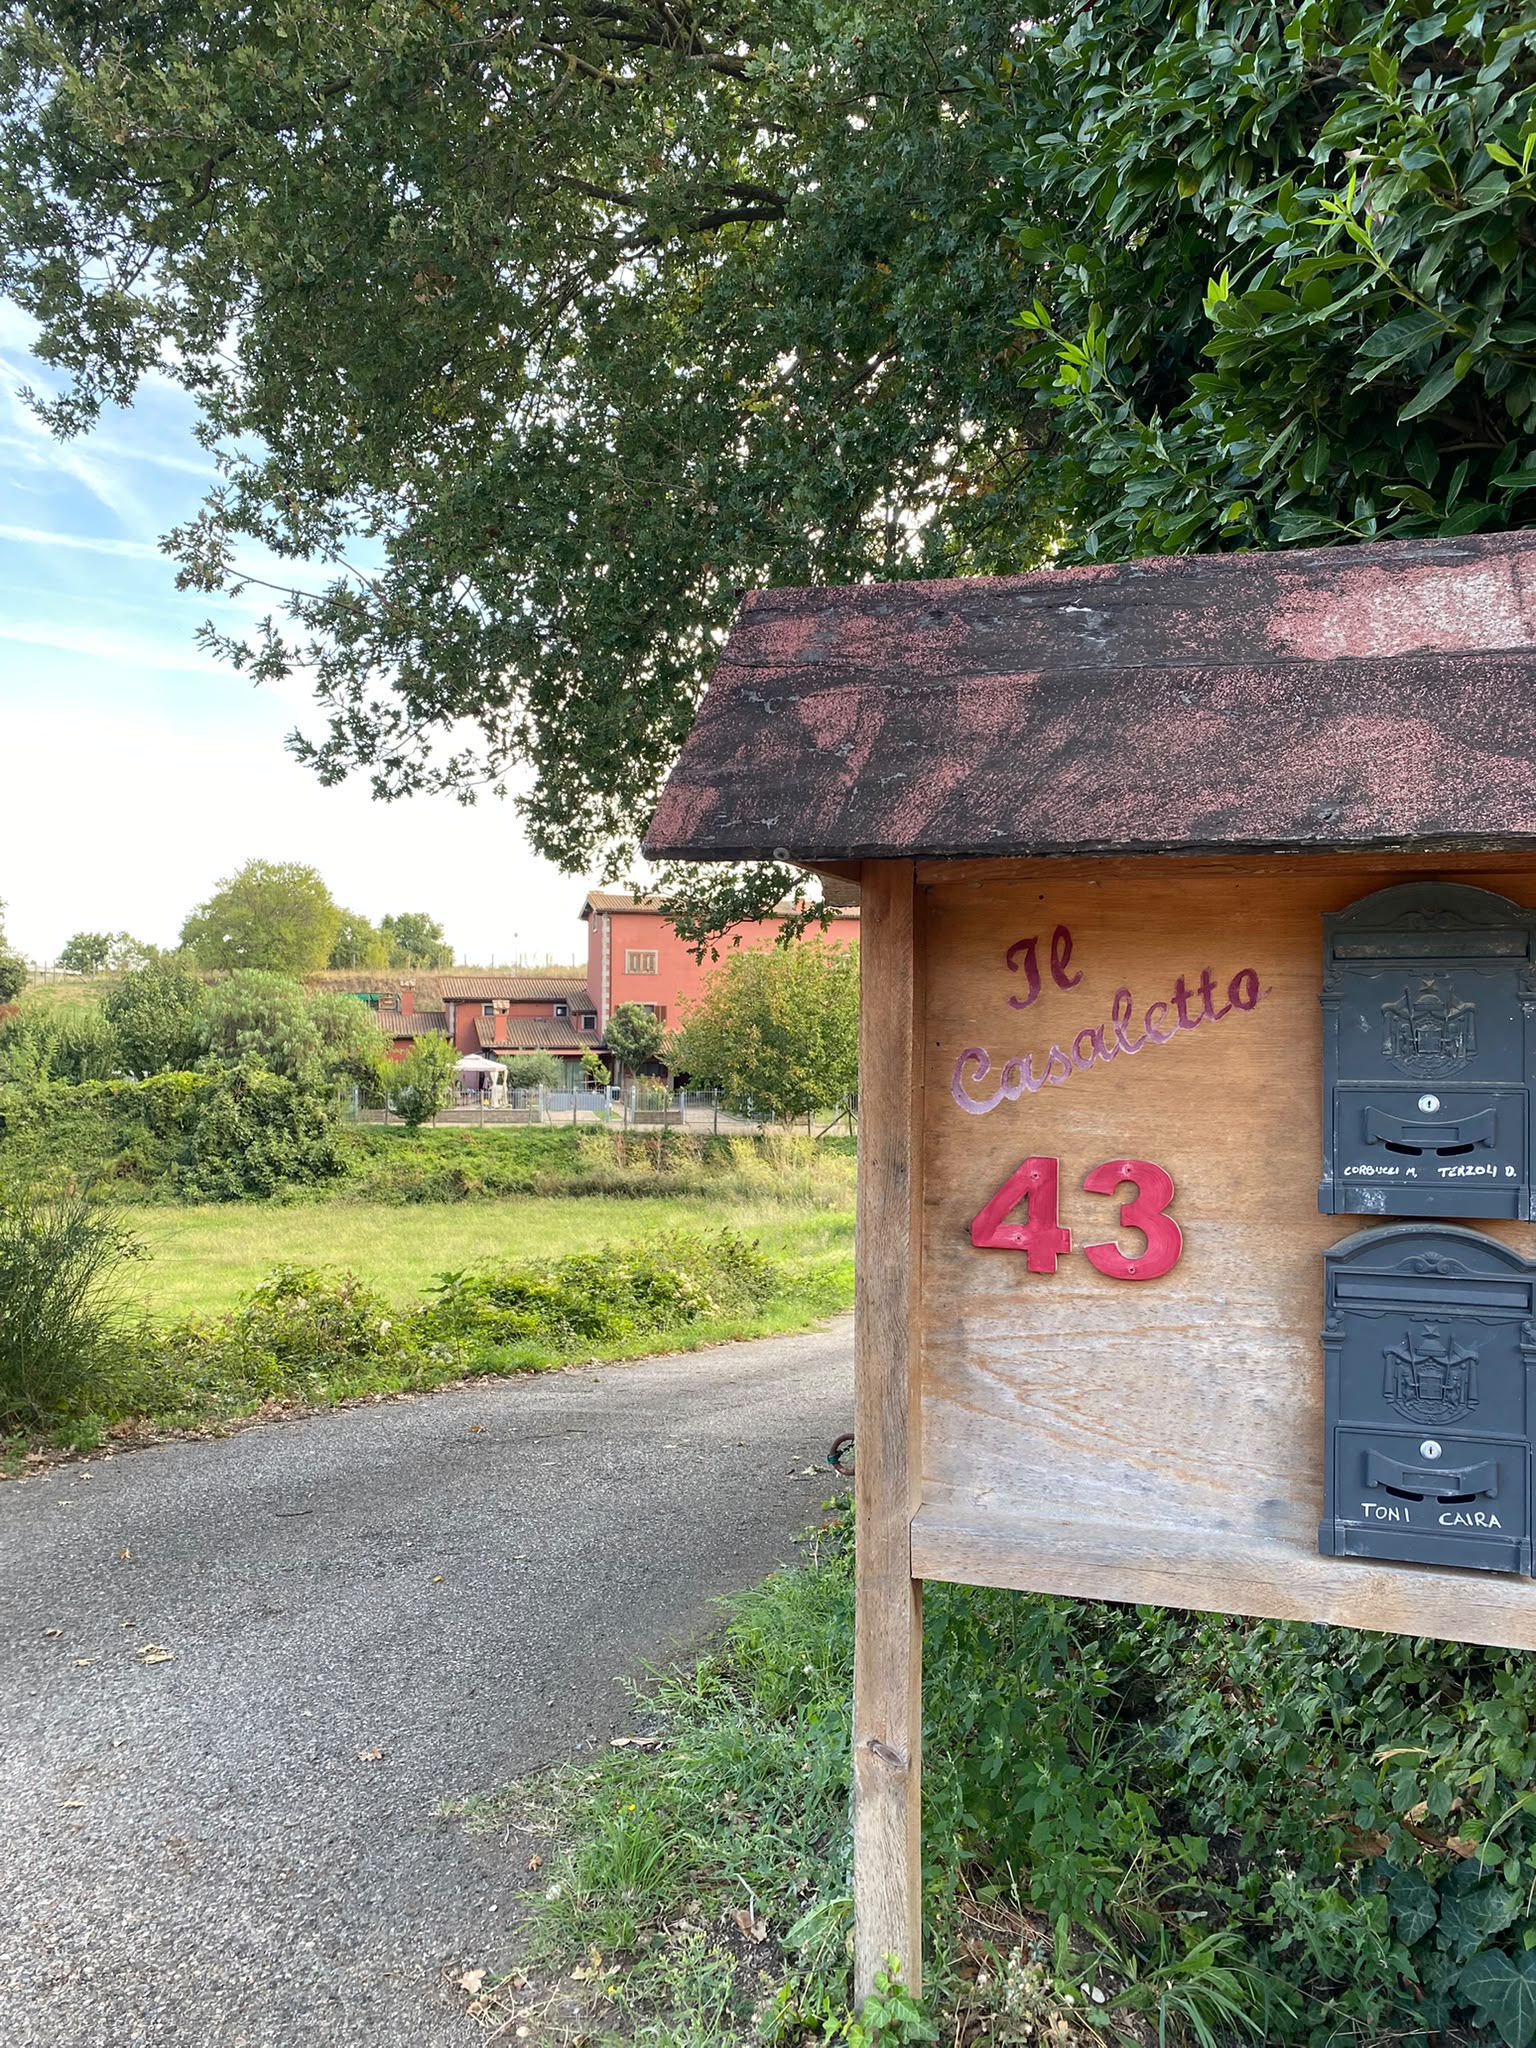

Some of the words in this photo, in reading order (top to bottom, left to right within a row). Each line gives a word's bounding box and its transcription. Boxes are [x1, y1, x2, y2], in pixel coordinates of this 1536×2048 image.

[1006, 924, 1083, 1010] Il
[951, 966, 1273, 1115] Casaletto
[1343, 1165, 1399, 1176] CORBUCCI
[1437, 1164, 1498, 1178] TERZOLI
[970, 1156, 1183, 1281] 43
[1360, 1502, 1411, 1523] TONI
[1438, 1511, 1502, 1529] CAIRA
